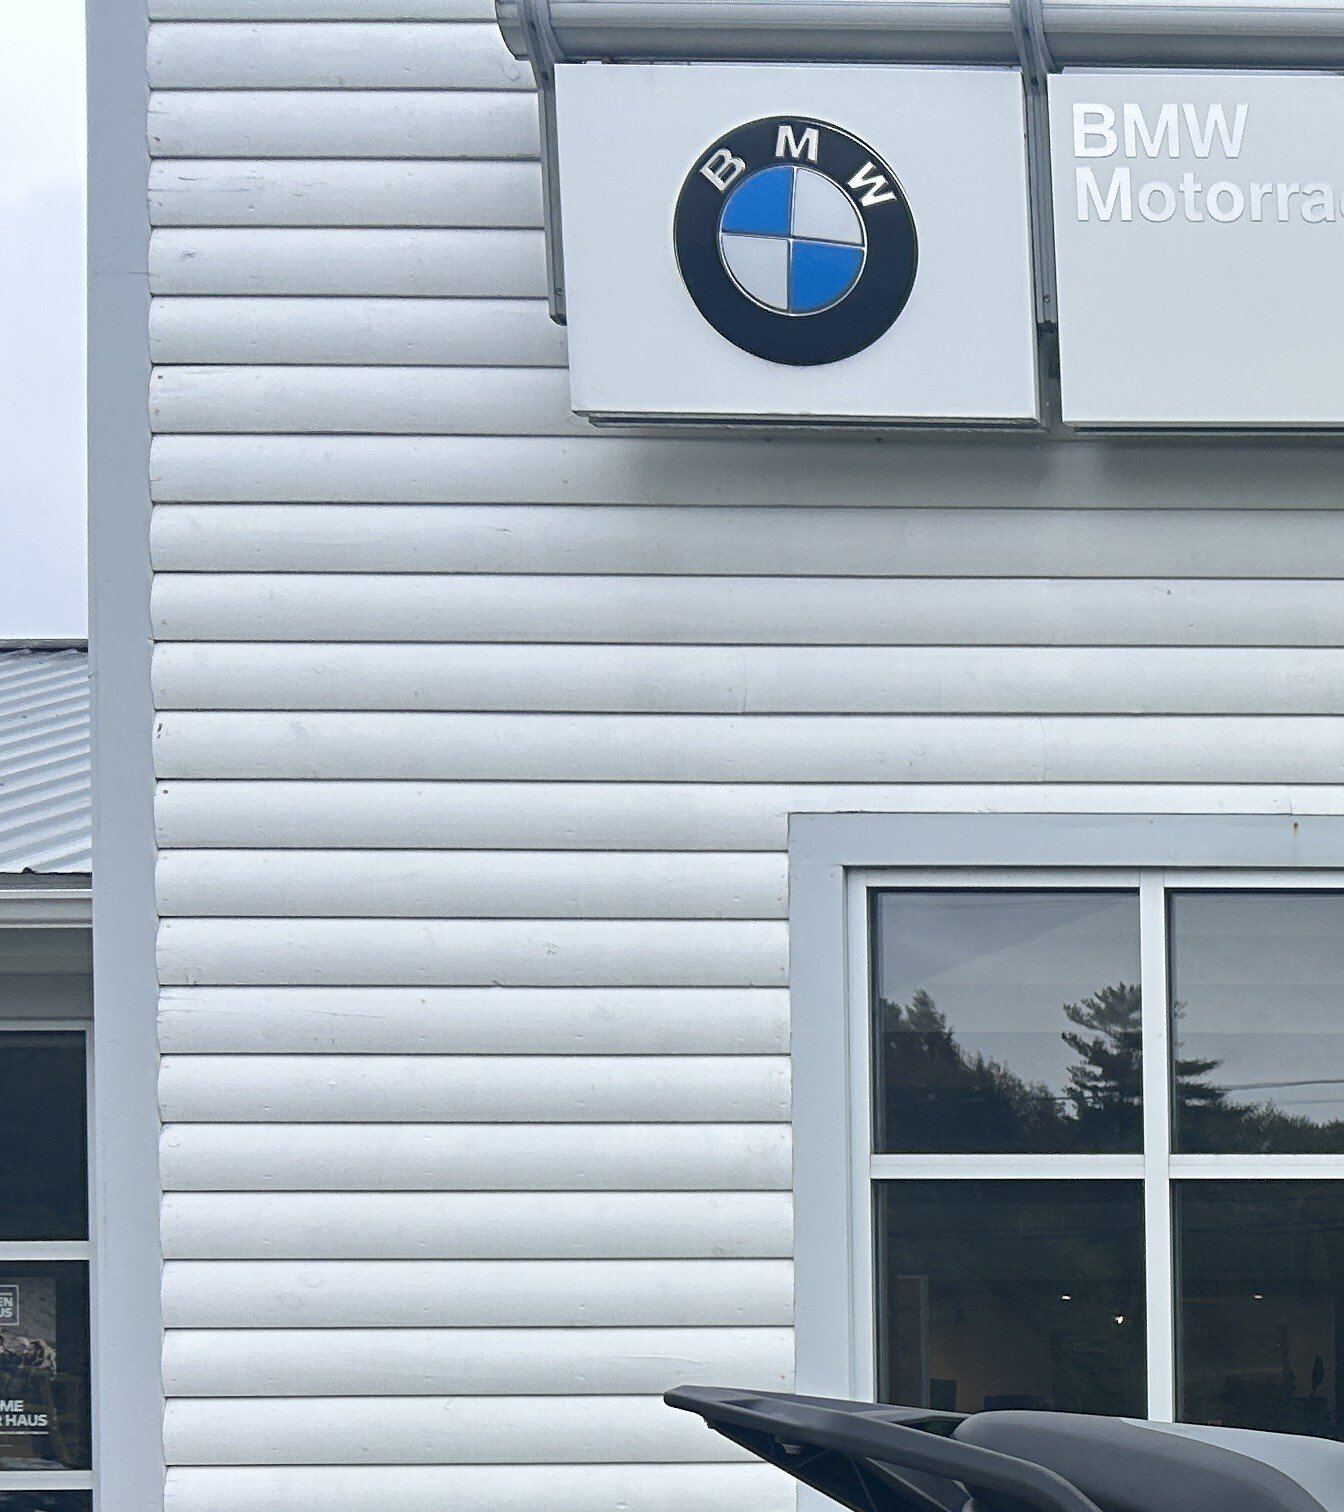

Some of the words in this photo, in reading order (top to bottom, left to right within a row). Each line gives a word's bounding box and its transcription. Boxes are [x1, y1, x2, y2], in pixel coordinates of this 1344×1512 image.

[1072, 102, 1249, 159] BMW
[700, 125, 896, 207] BMW
[5, 1413, 48, 1427] HAUS
